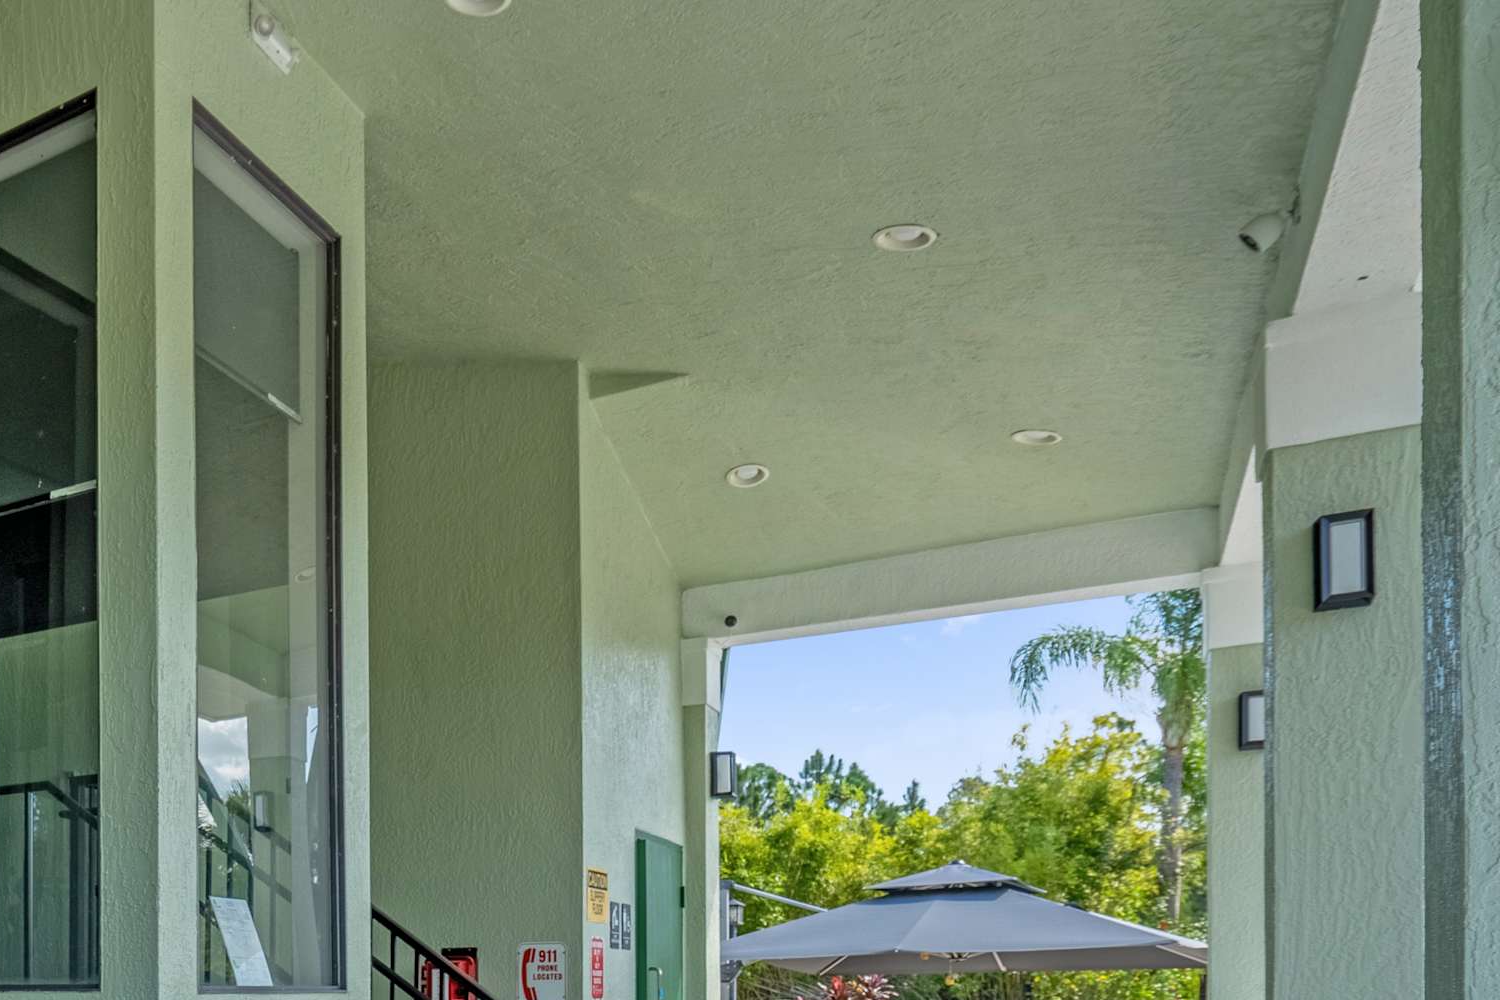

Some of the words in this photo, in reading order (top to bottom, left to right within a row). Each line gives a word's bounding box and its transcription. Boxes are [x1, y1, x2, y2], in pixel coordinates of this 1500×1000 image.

[539, 949, 557, 963] 911
[537, 964, 558, 972] PHONE
[532, 973, 563, 981] LOCATED
